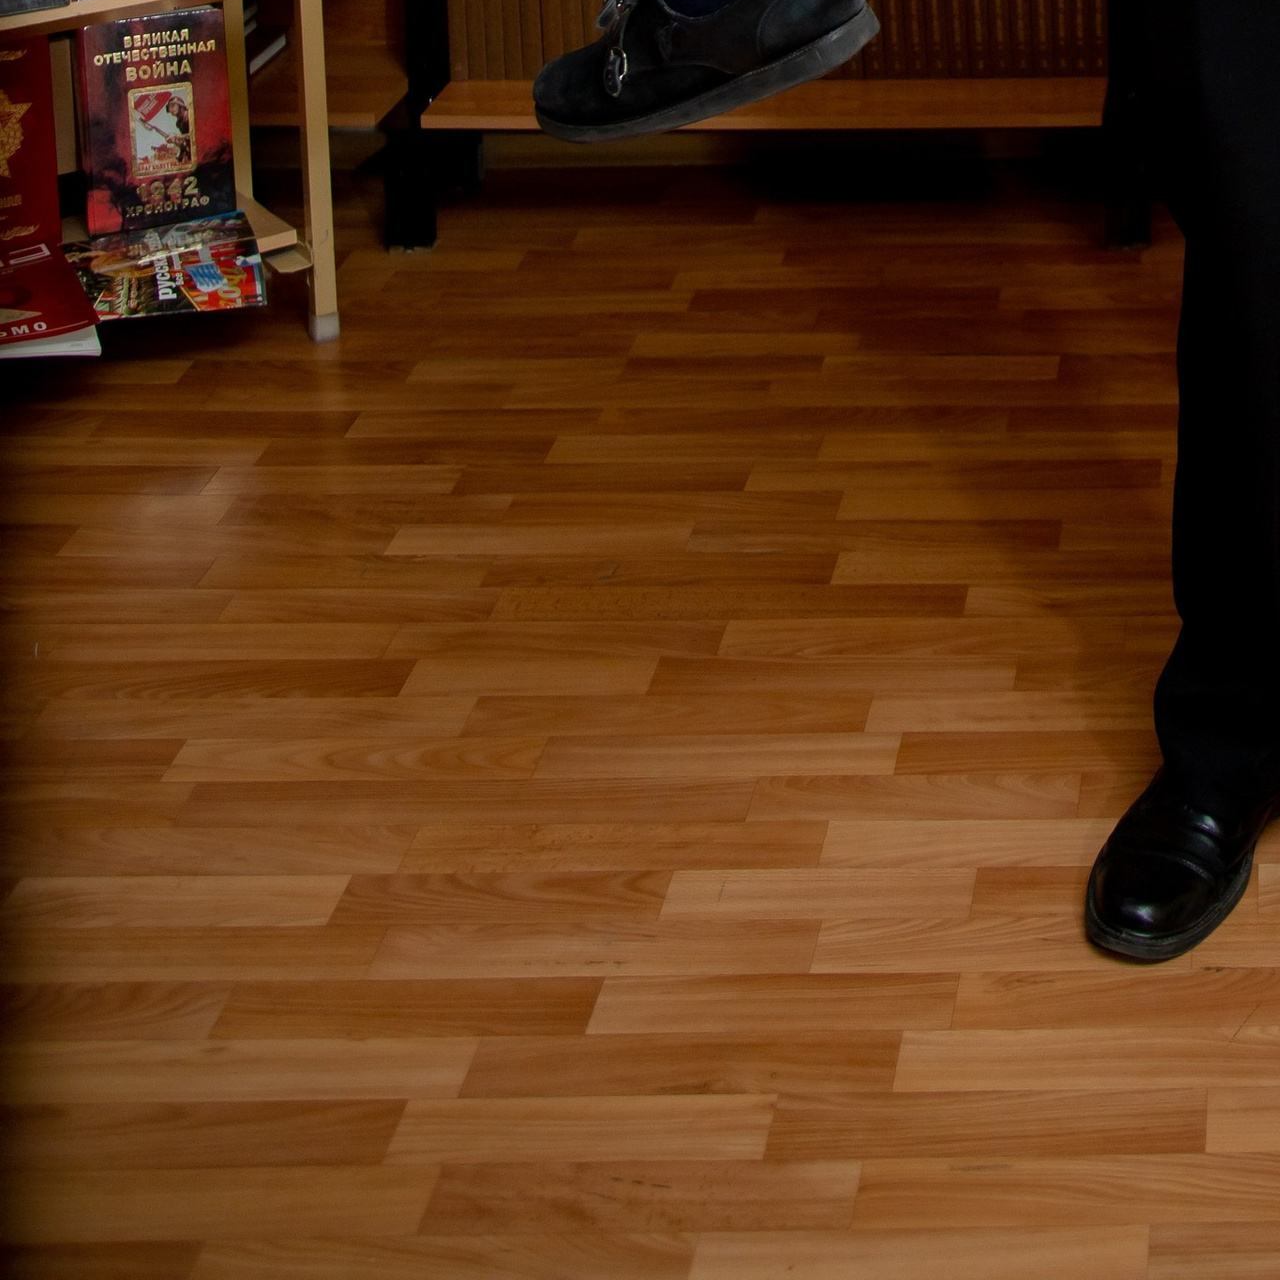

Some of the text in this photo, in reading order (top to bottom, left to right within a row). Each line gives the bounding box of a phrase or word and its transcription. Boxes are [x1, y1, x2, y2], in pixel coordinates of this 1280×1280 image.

[124, 28, 189, 48] ВЕЛИКАЯ
[94, 40, 216, 66] ОТЕЧЕСТВЕННАЯ
[126, 60, 192, 82] ВОЙНА
[136, 176, 199, 202] 1942
[126, 196, 210, 218] ХРОНОГРАФ
